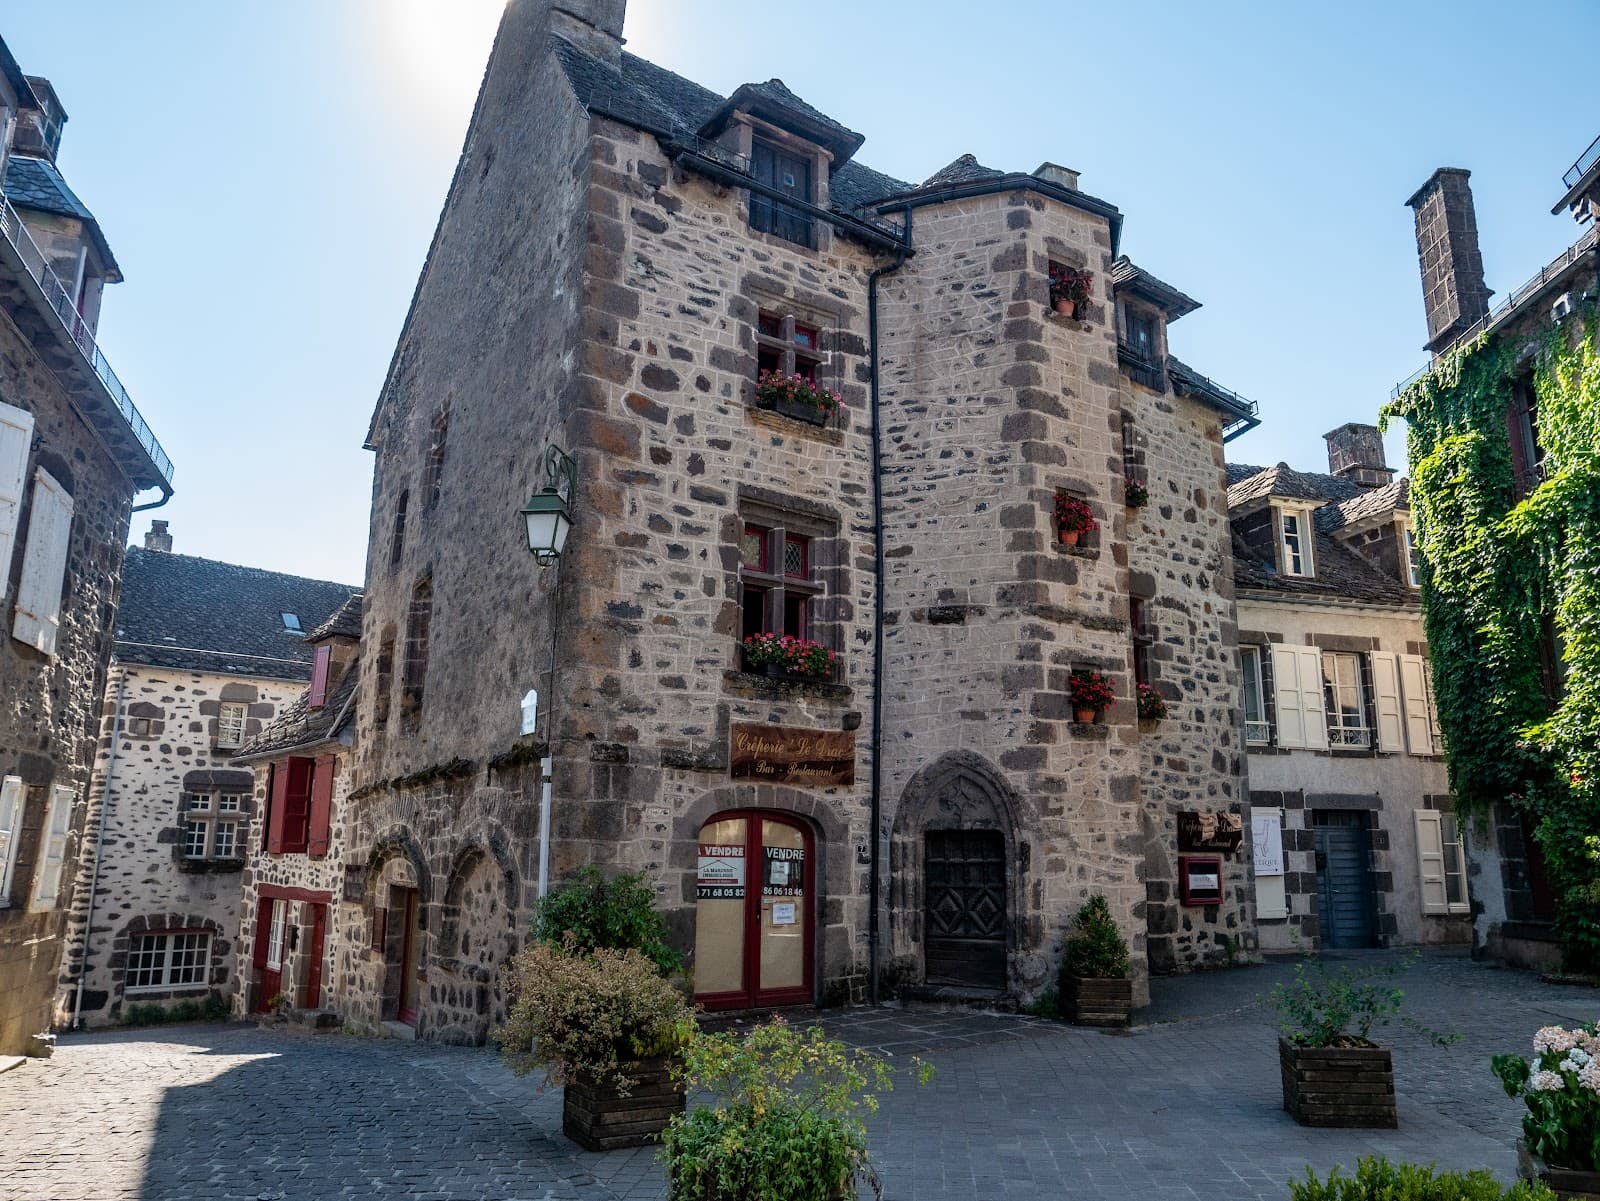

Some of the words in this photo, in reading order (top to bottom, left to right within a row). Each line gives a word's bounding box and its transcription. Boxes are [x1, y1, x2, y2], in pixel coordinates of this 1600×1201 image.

[736, 732, 785, 759] Crêperie
[756, 760, 775, 774] Bar
[787, 761, 834, 778] Restaurant
[705, 846, 744, 857] VENDRE
[766, 847, 805, 860] VENDRE
[701, 888, 711, 897] 71
[712, 888, 723, 897] 68
[724, 888, 734, 897] 05
[735, 888, 745, 897] 82
[763, 886, 773, 895] 86
[784, 888, 793, 896] 18
